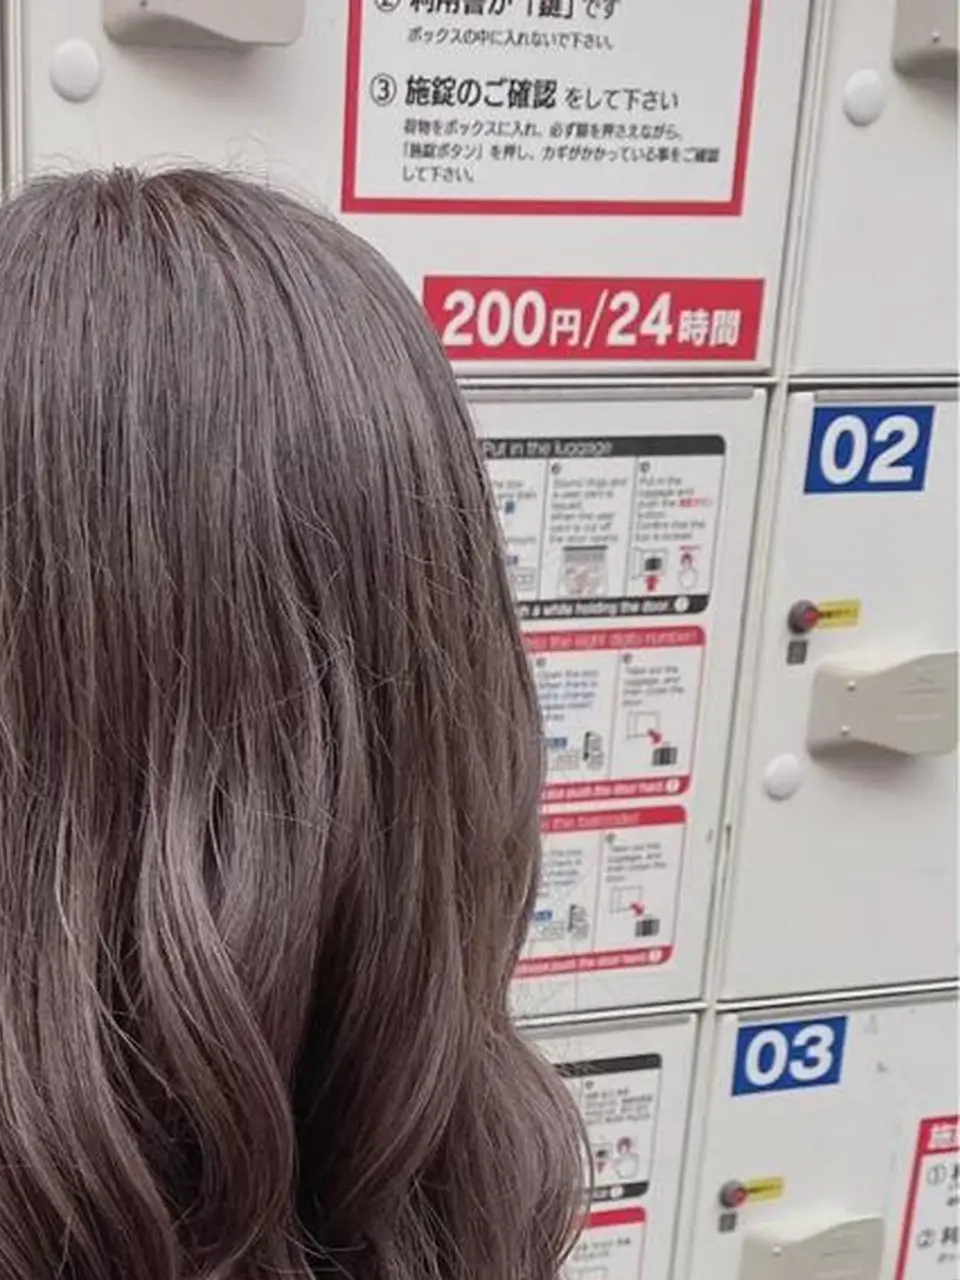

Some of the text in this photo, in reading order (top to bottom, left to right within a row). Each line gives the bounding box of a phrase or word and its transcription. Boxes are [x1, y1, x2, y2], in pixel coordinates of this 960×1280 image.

[370, 73, 397, 107] ③
[442, 289, 741, 350] 200円/24時間
[820, 414, 920, 484] 02
[745, 1023, 835, 1086] 03
